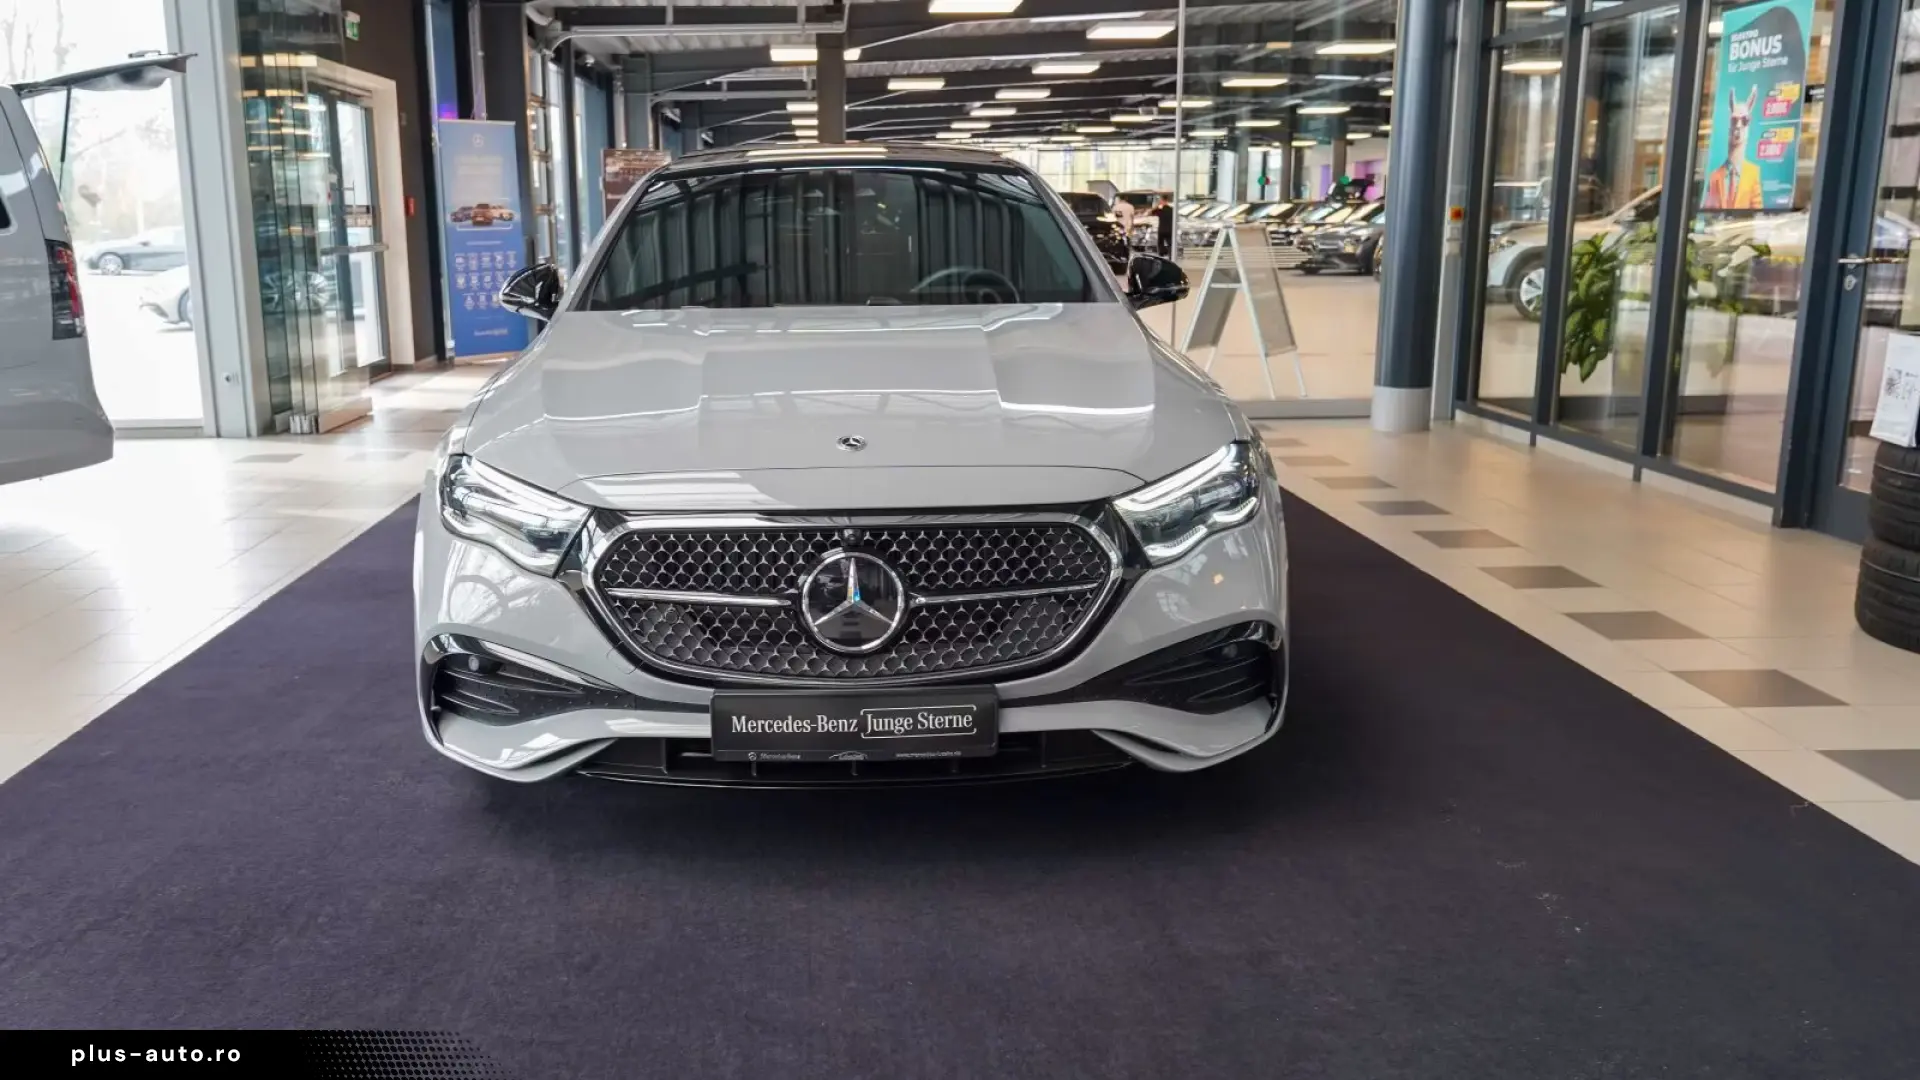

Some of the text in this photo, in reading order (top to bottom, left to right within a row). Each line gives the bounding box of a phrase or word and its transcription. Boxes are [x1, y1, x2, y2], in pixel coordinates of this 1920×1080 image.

[1729, 34, 1783, 61] BONUS
[1738, 60, 1761, 72] Junge
[1762, 56, 1789, 68] Sterne
[731, 711, 973, 734] Mercedes-Benz Junge Sterne
